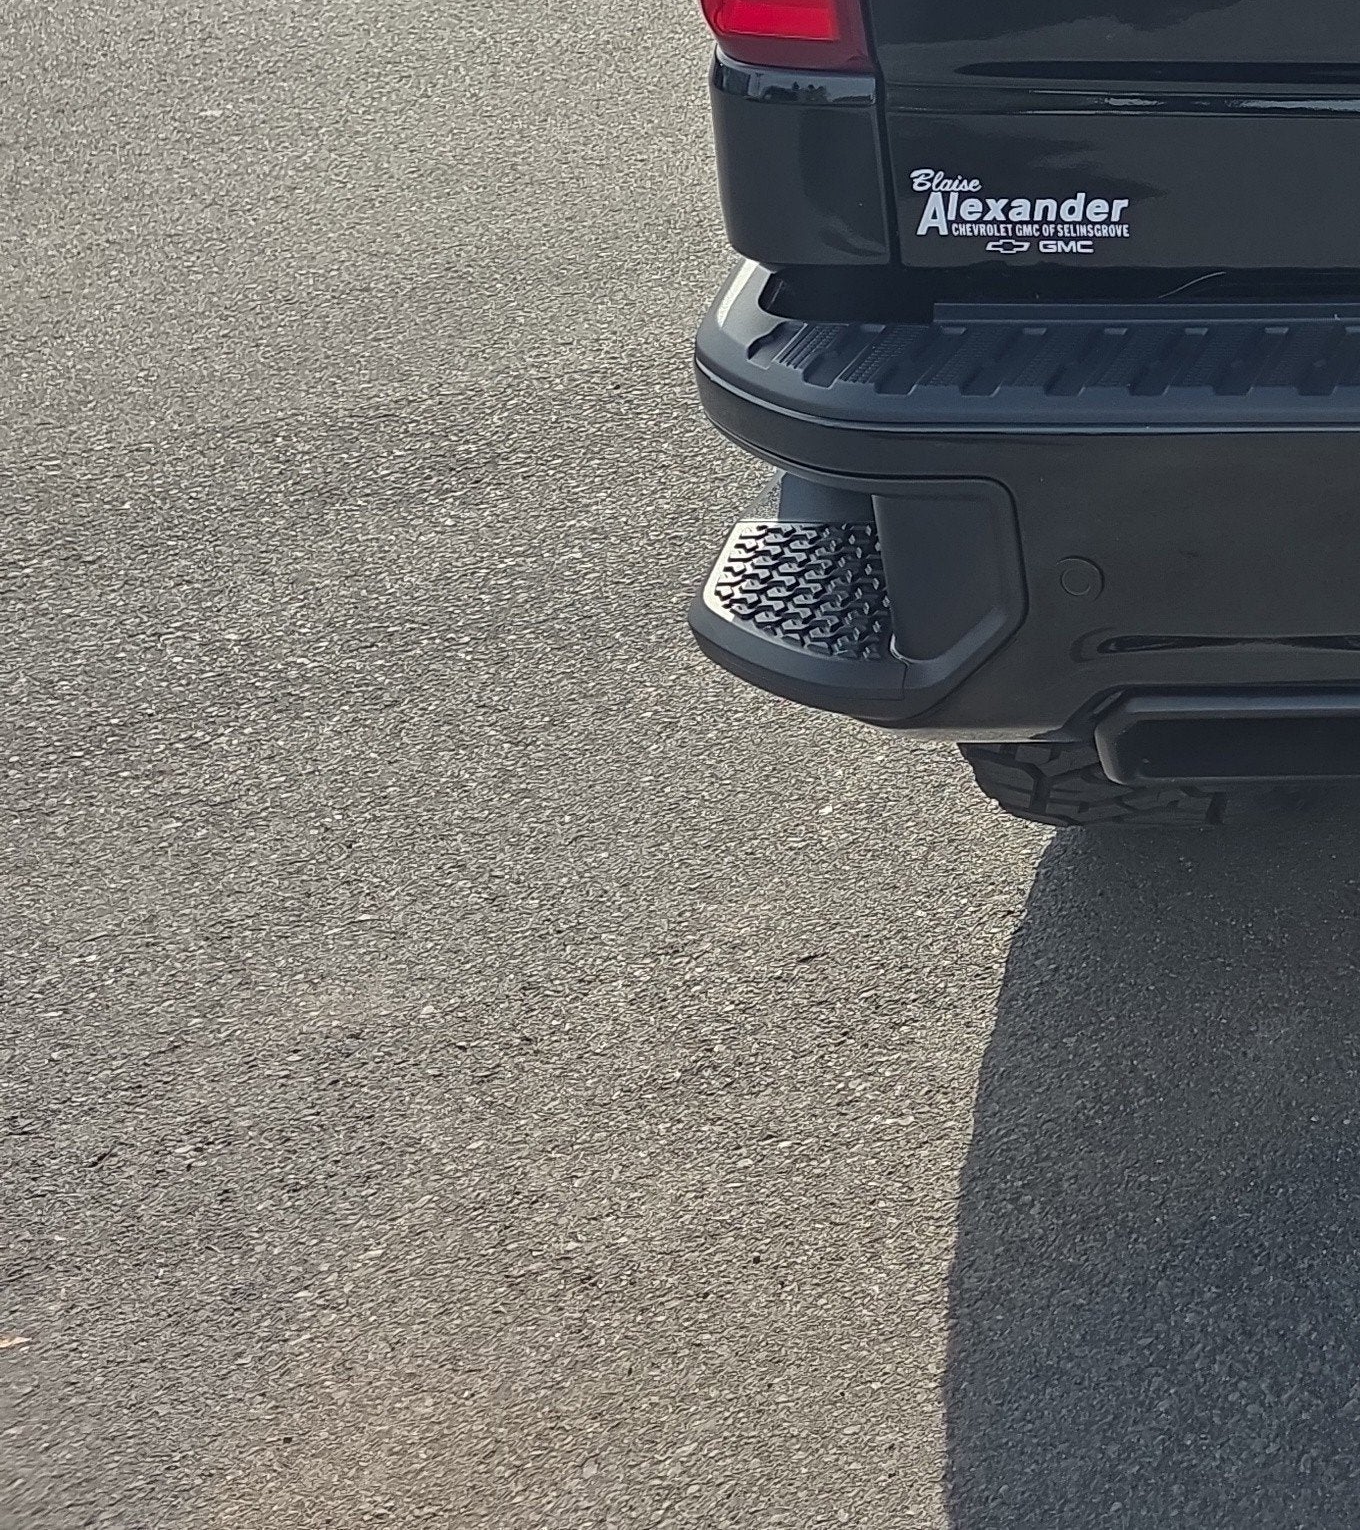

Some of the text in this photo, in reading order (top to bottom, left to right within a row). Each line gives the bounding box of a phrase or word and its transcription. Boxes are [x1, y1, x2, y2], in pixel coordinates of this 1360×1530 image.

[910, 168, 983, 193] Blaise
[916, 191, 1130, 236] Alexander
[951, 223, 1130, 238] CHEVROLET GMC OF SELINSGROVE
[1038, 240, 1095, 254] GMC
